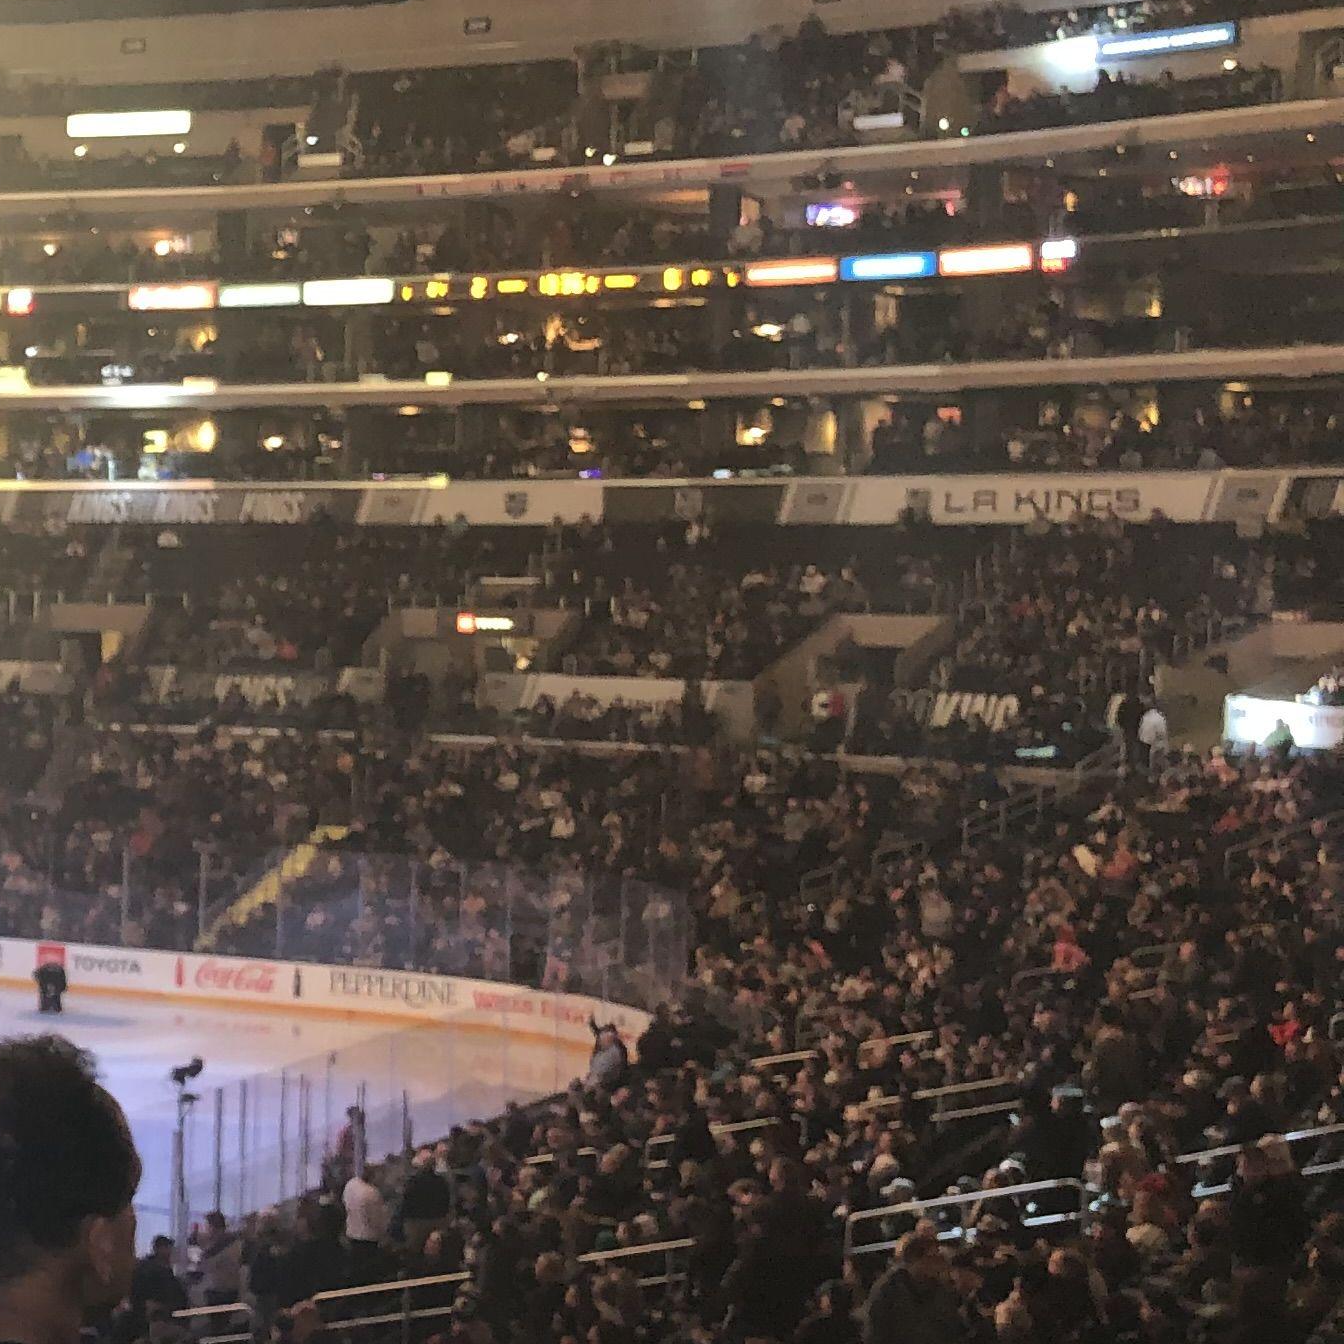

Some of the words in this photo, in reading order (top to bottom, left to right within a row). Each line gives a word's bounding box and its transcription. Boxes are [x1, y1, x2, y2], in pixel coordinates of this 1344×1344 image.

[944, 490, 998, 513] LA
[1015, 488, 1141, 513] KINGS
[74, 955, 142, 975] TOYOTA
